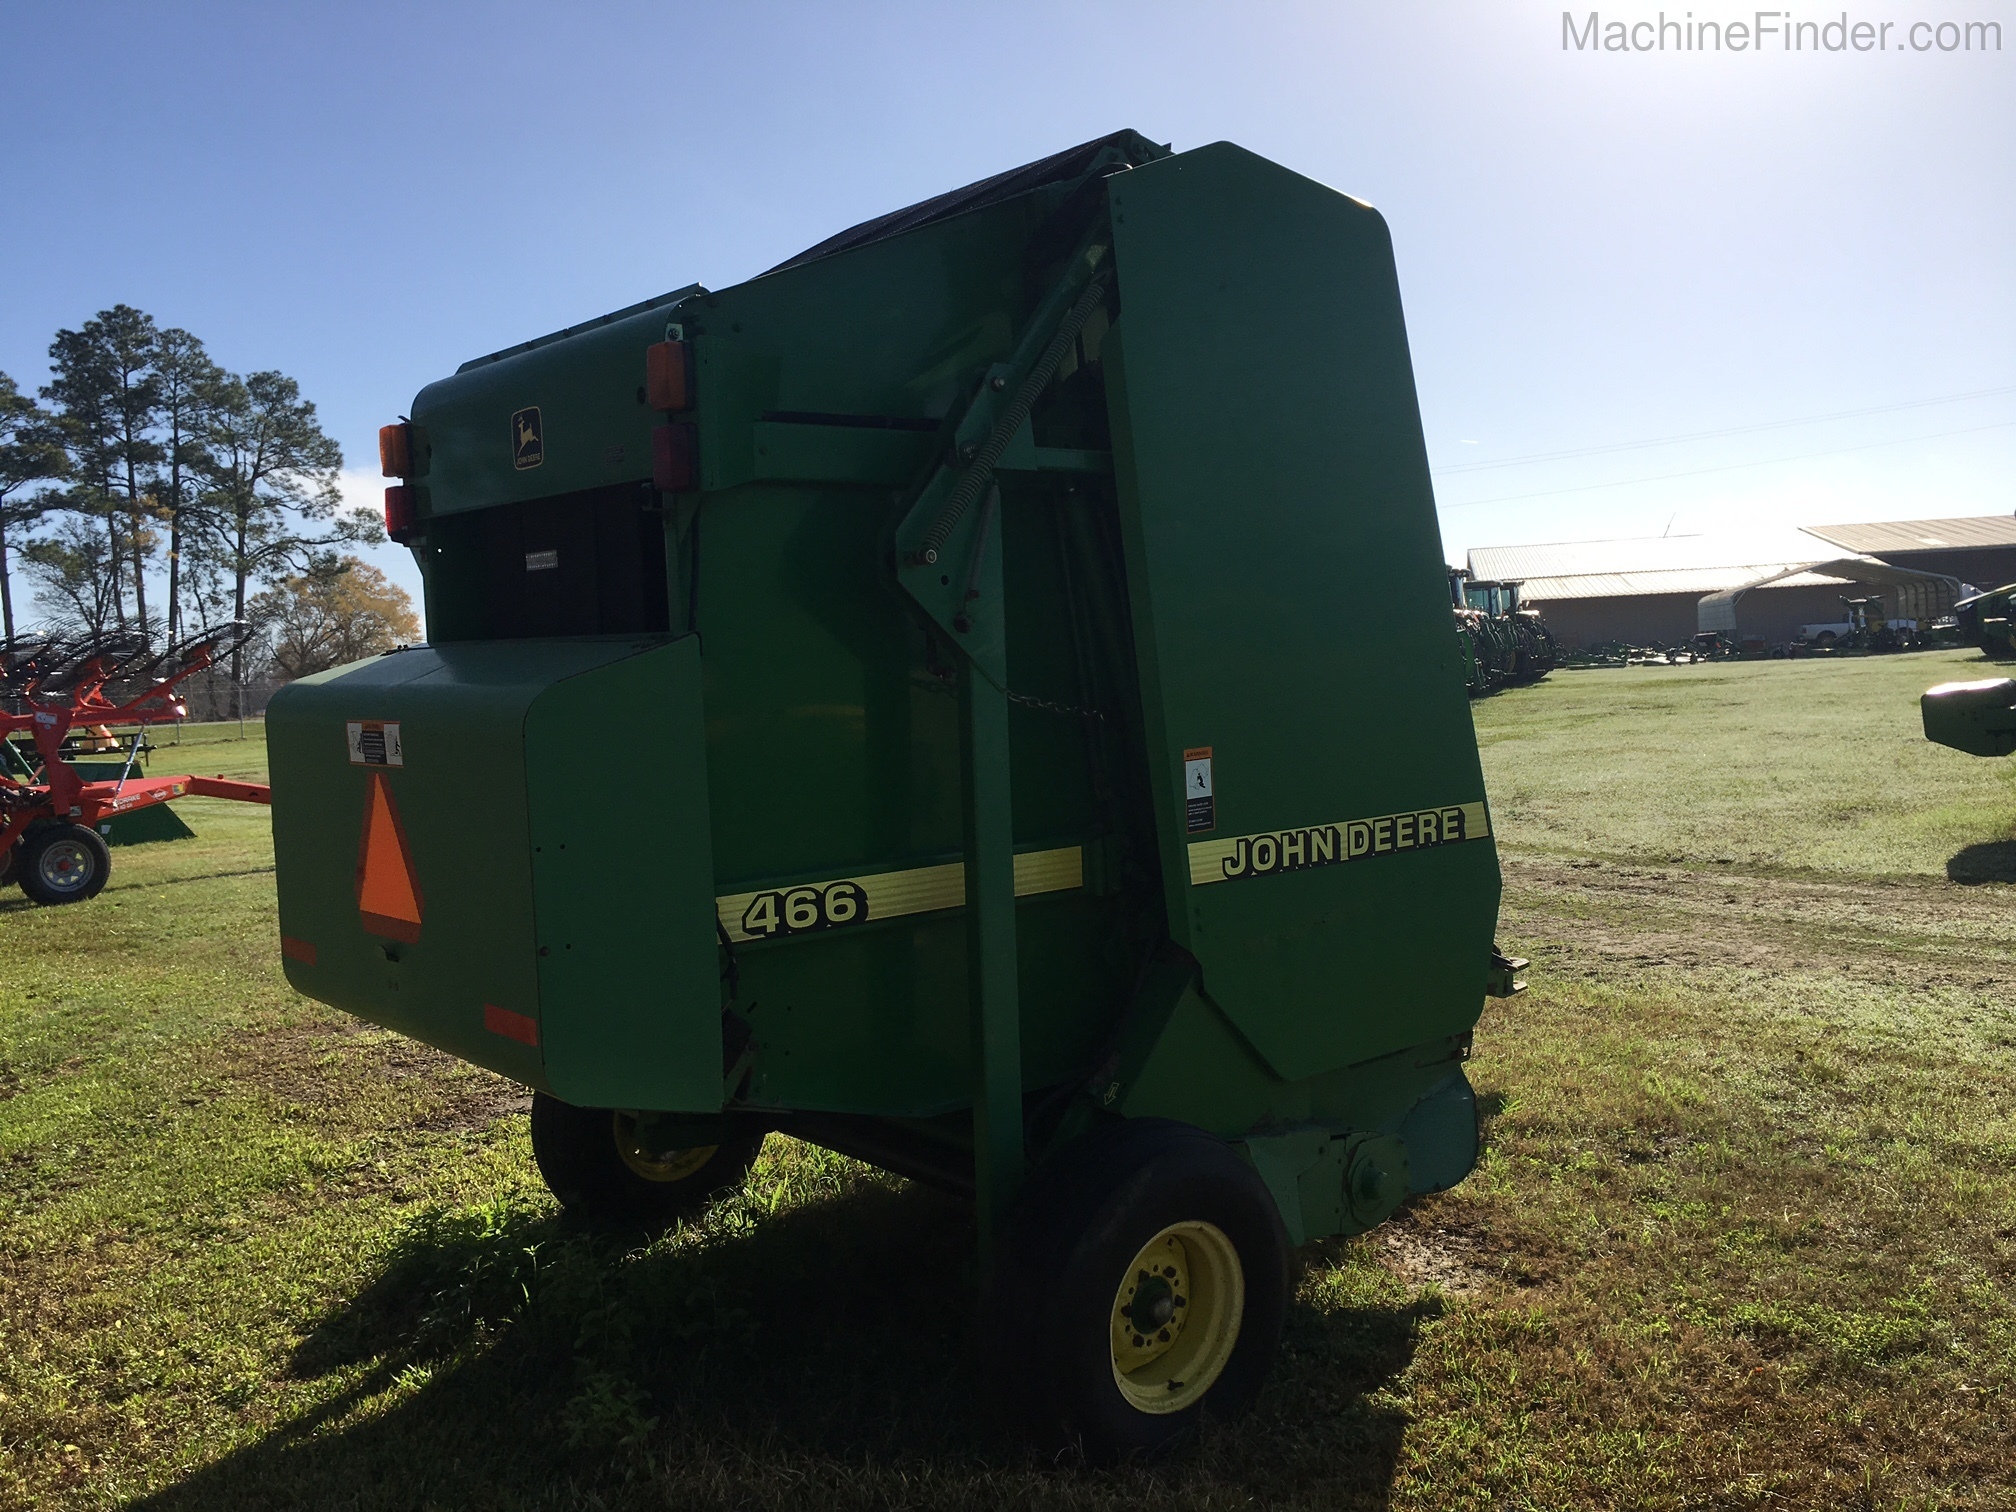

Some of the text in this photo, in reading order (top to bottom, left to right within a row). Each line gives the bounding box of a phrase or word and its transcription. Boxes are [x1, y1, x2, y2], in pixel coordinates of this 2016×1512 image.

[1222, 808, 1462, 878] JOHN DEERE
[743, 882, 863, 935] 466
